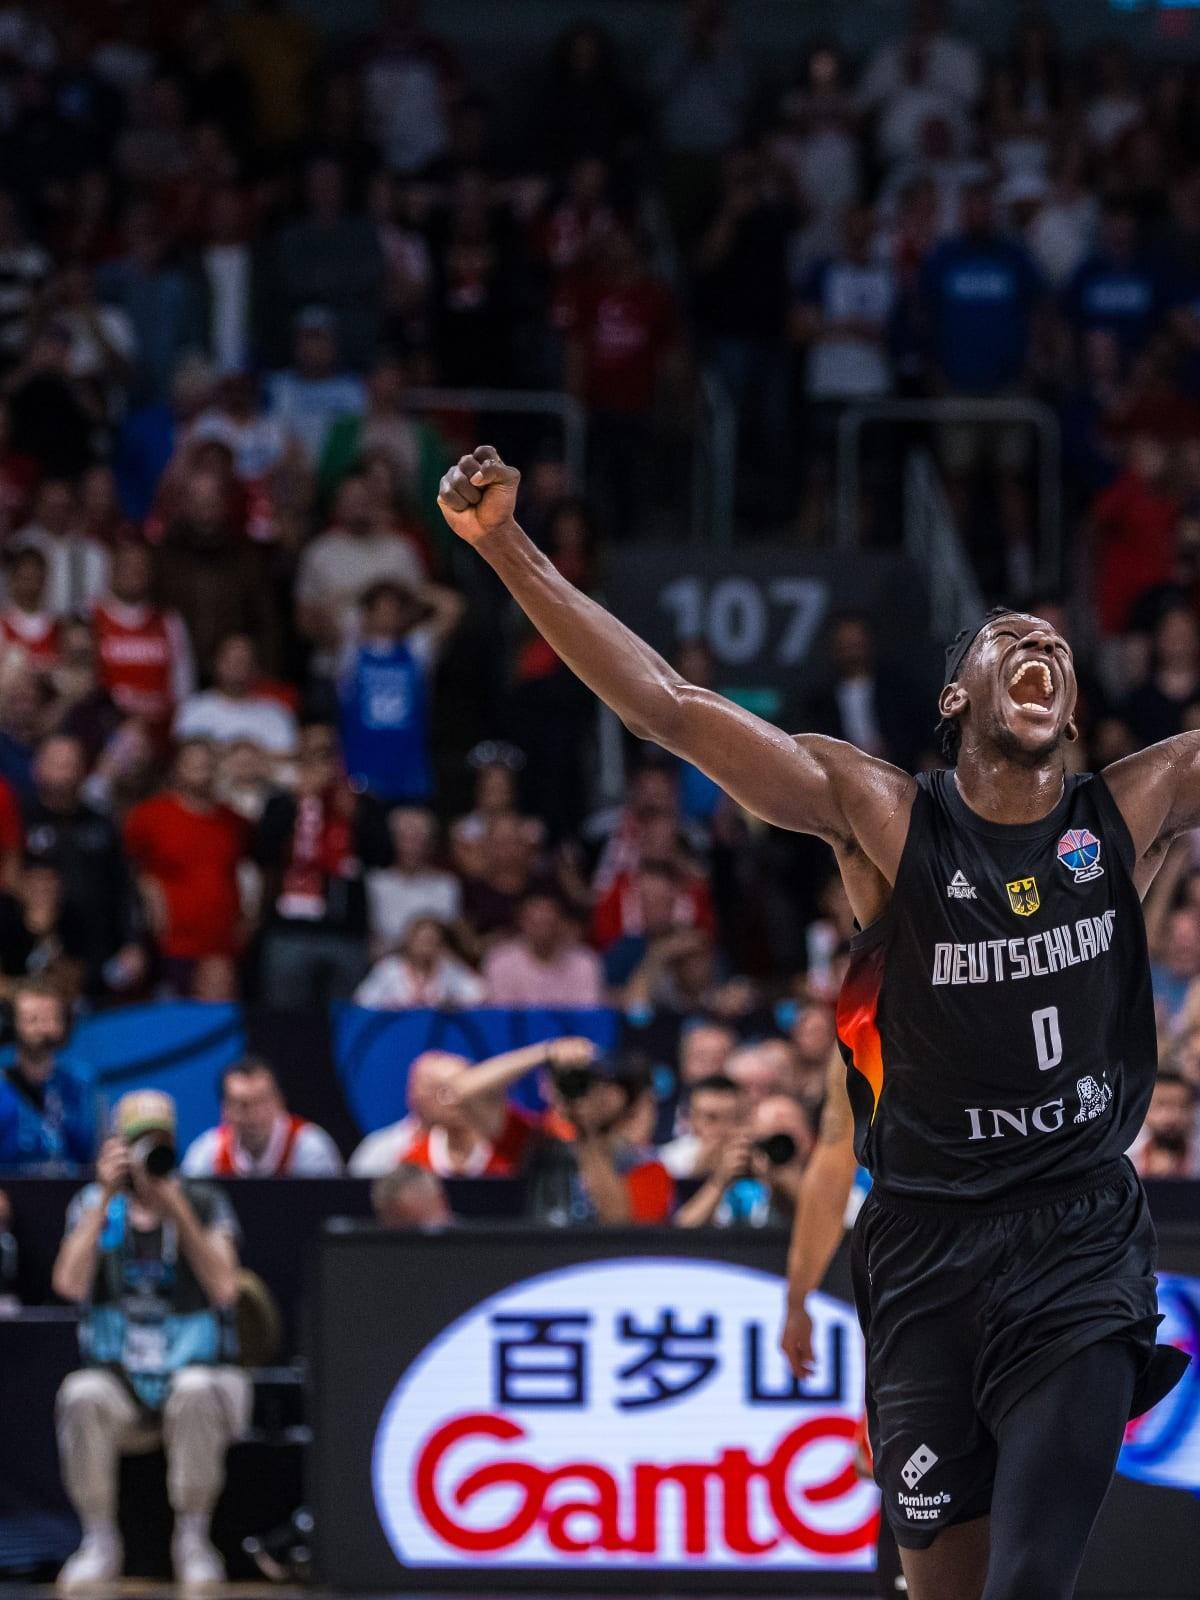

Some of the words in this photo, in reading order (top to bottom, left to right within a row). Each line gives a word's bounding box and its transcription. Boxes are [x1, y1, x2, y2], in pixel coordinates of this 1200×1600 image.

[658, 575, 829, 666] 107
[946, 885, 978, 900] PEAK
[1032, 1006, 1063, 1071] 0
[965, 1097, 1066, 1140] ING
[490, 1309, 845, 1411] 百岁山
[898, 1491, 952, 1506] Domino's
[905, 1507, 939, 1520] Pizza
